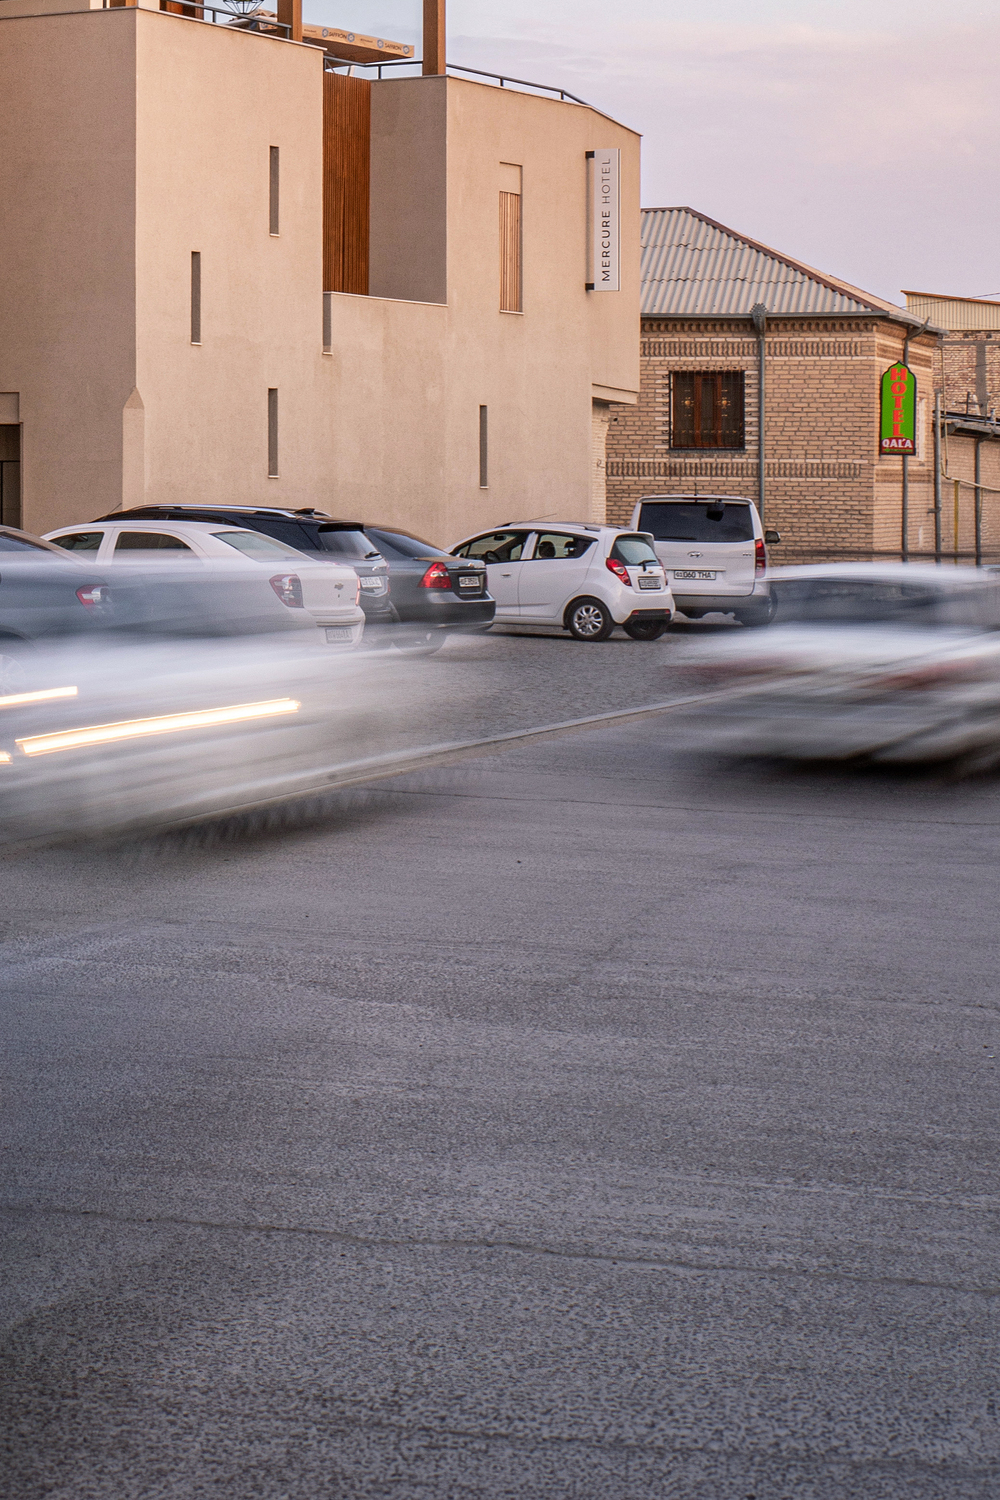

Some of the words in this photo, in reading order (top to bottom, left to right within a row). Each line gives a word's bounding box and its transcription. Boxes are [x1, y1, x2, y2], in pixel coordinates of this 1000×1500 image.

[601, 158, 611, 204] HOTEL
[601, 210, 611, 282] MERCURE
[890, 368, 908, 436] HOTEL
